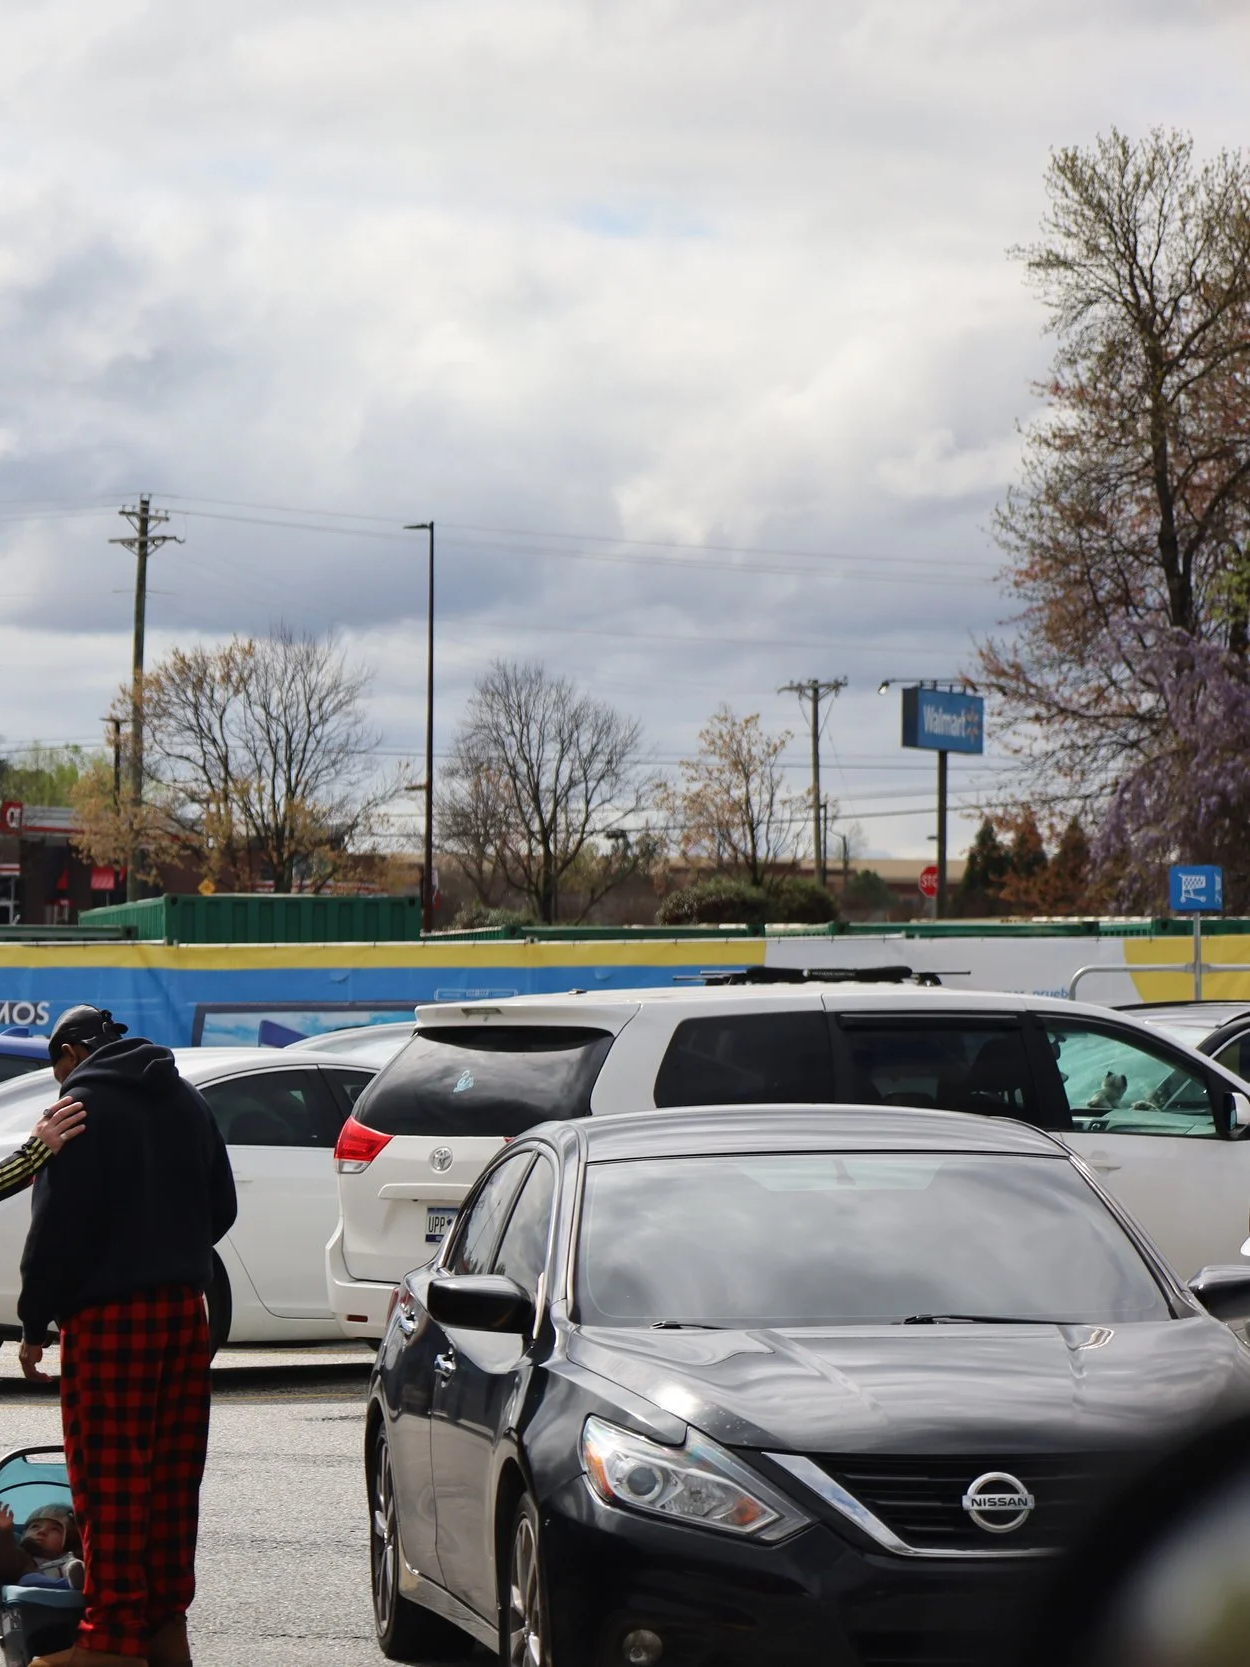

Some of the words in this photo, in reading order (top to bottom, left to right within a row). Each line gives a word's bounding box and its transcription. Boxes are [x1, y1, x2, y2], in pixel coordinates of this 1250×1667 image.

[923, 704, 966, 738] Walmart
[921, 874, 938, 888] STO
[428, 1216, 446, 1233] UPP
[971, 1497, 1028, 1507] NISSAN
